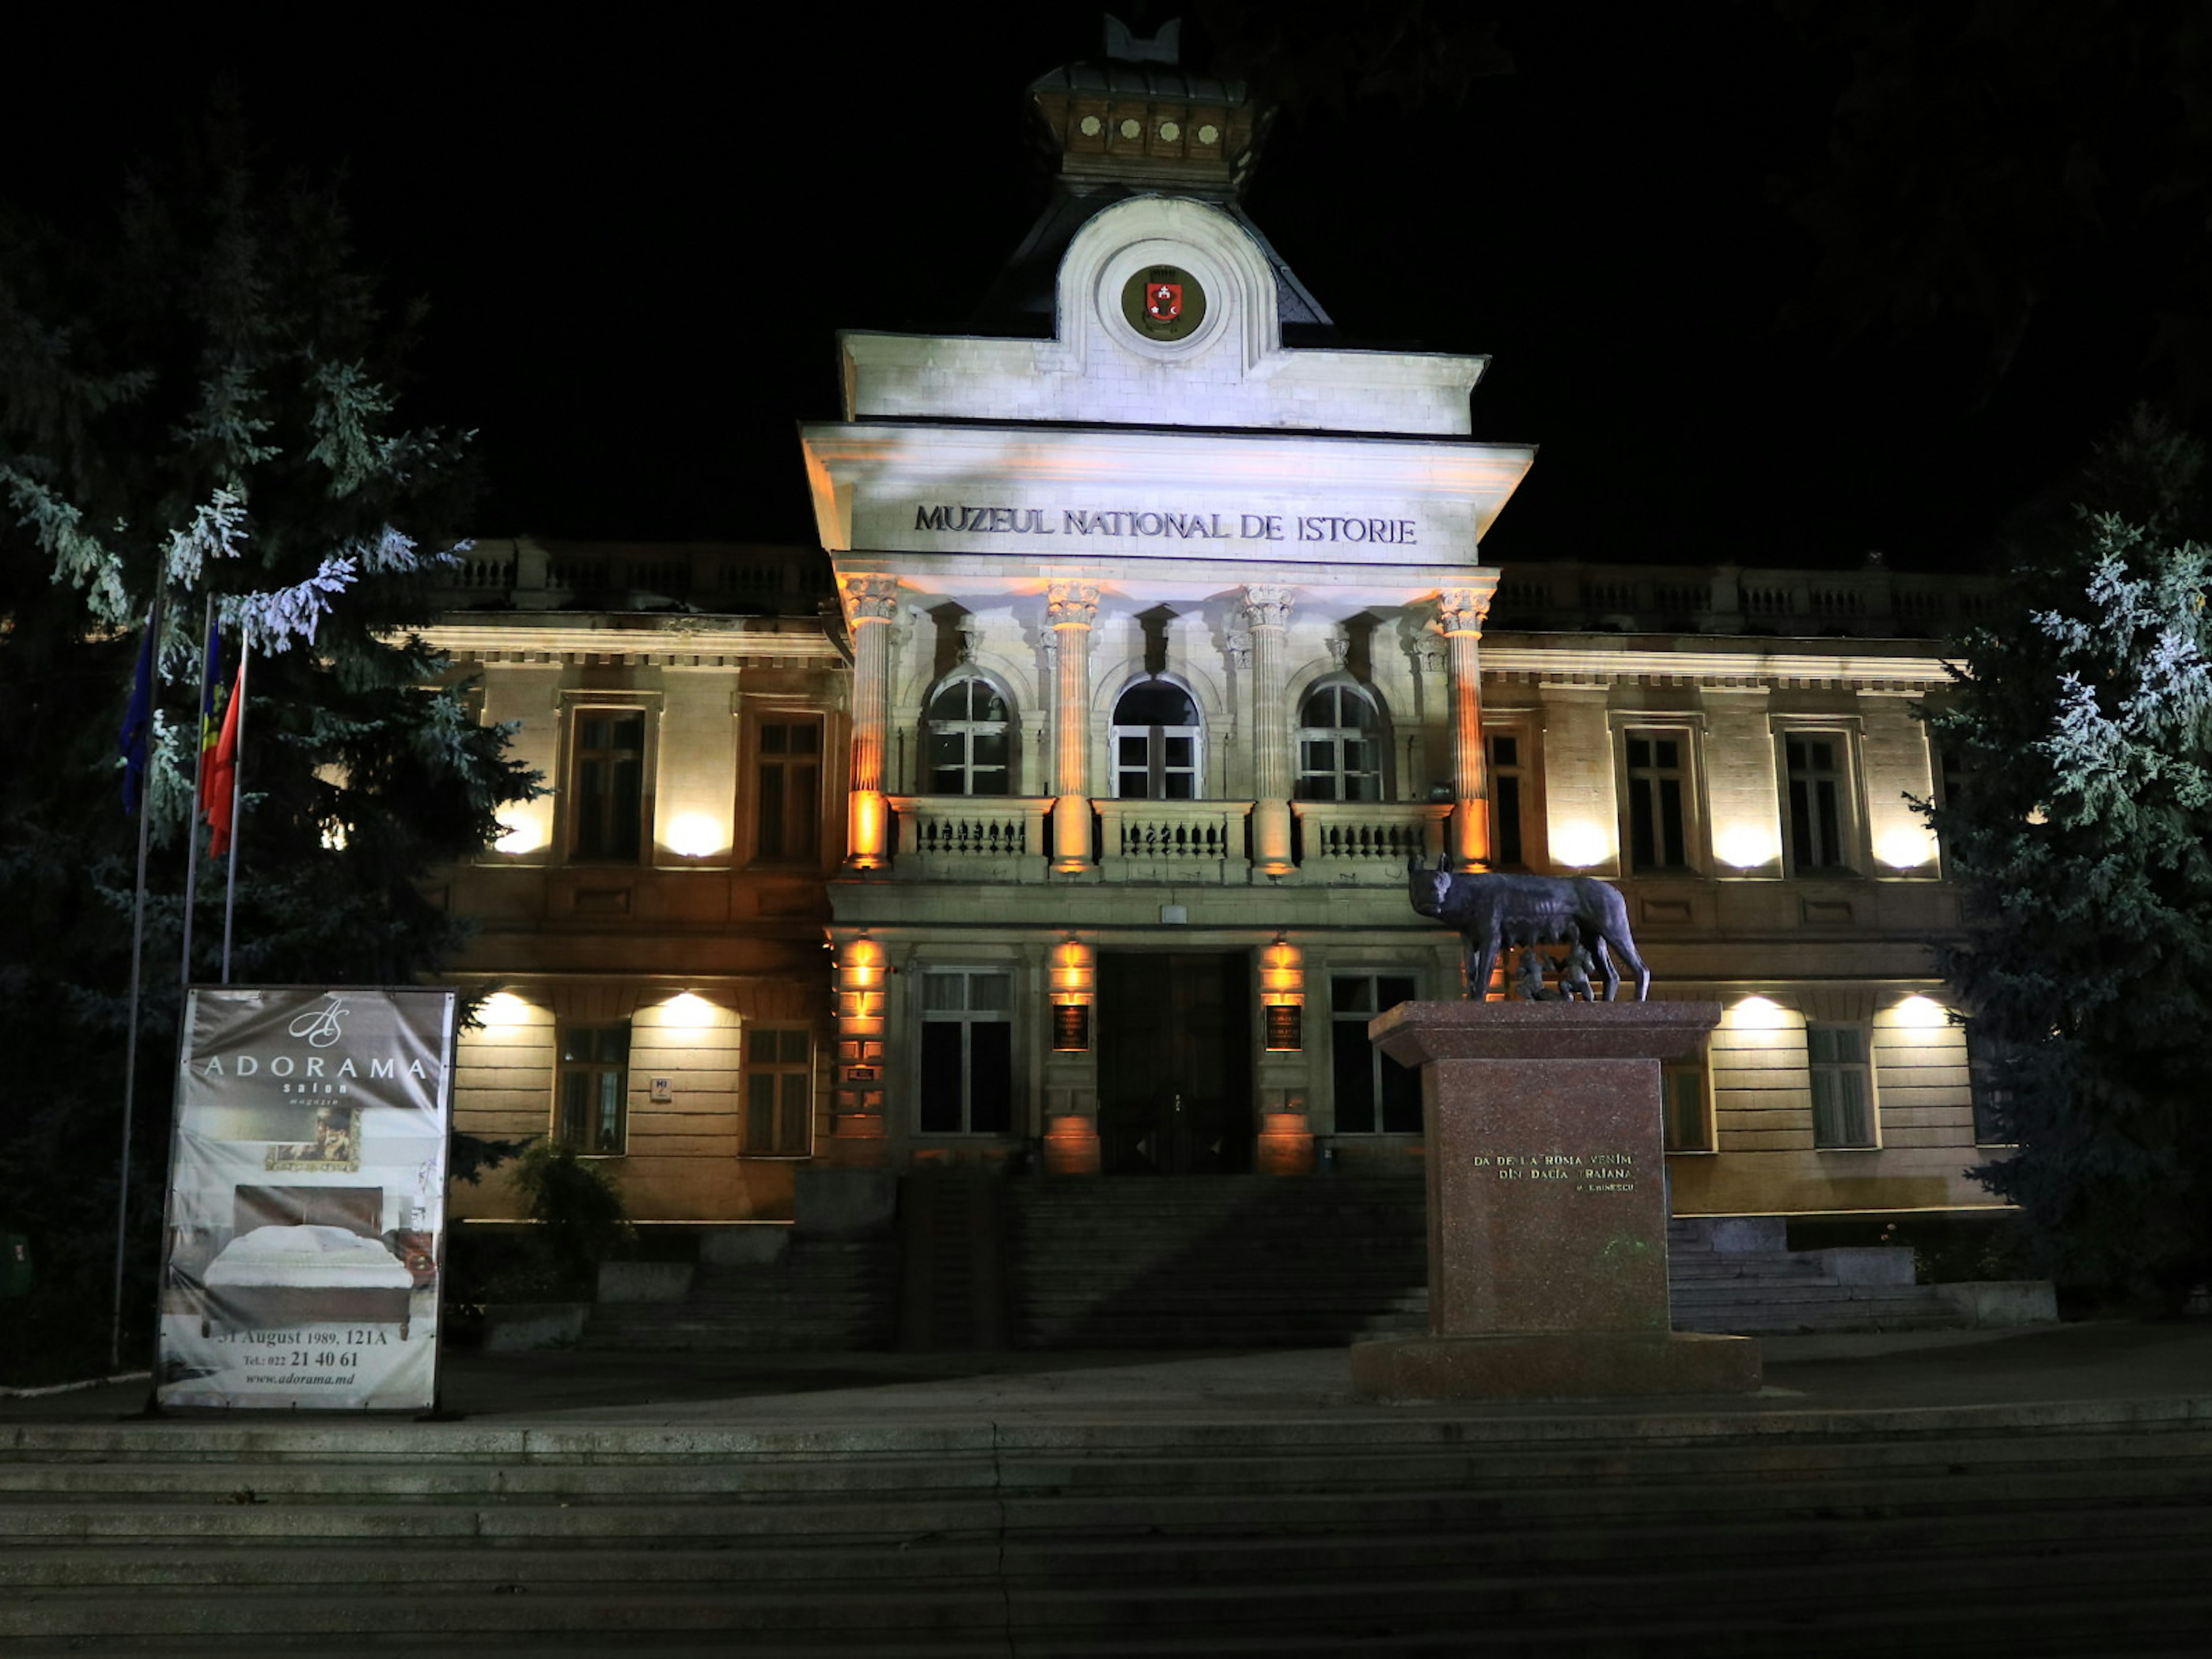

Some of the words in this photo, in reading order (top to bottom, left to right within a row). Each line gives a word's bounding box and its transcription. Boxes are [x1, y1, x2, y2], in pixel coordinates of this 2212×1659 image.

[915, 505, 1055, 534] MUZEUL
[1063, 509, 1232, 539] NATIONAL
[1240, 514, 1284, 541] DE
[1297, 516, 1418, 545] ISTORIE
[204, 1055, 426, 1080] ADORAMA
[283, 1082, 347, 1094] salon
[1474, 1156, 1490, 1166] DA
[1497, 1156, 1516, 1165] DE
[1544, 1155, 1582, 1165] ROMA
[242, 1329, 301, 1348] August
[347, 1330, 387, 1344] 121A
[268, 1356, 286, 1366] 022
[290, 1351, 308, 1366] 21
[316, 1351, 335, 1366] 40
[340, 1352, 358, 1366] 61
[247, 1373, 355, 1385] www.adorama.md
